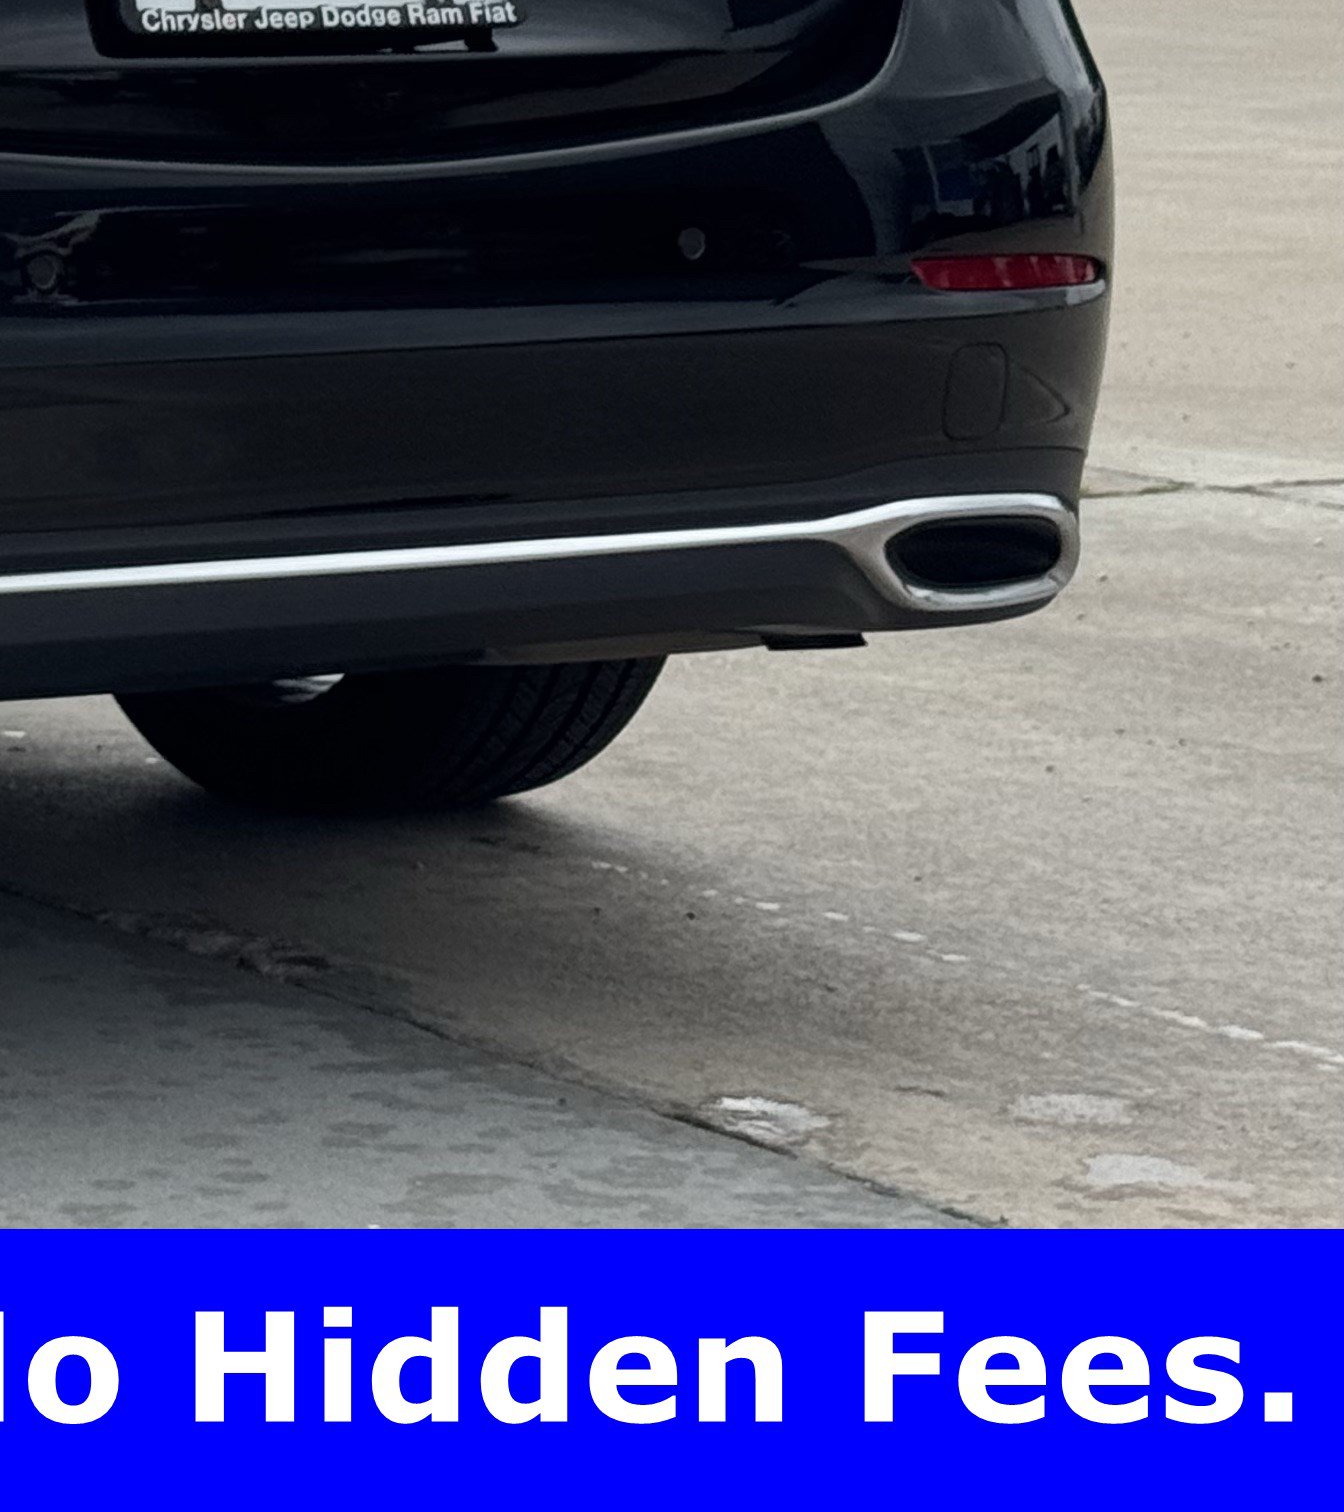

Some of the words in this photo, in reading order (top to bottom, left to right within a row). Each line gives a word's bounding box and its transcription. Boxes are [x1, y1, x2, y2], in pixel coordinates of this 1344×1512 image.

[141, 8, 248, 33] Chrysler
[254, 7, 314, 30] Jeep
[320, 5, 401, 28] Dodge
[407, 3, 463, 25] Ram
[469, 1, 517, 24] Fiat
